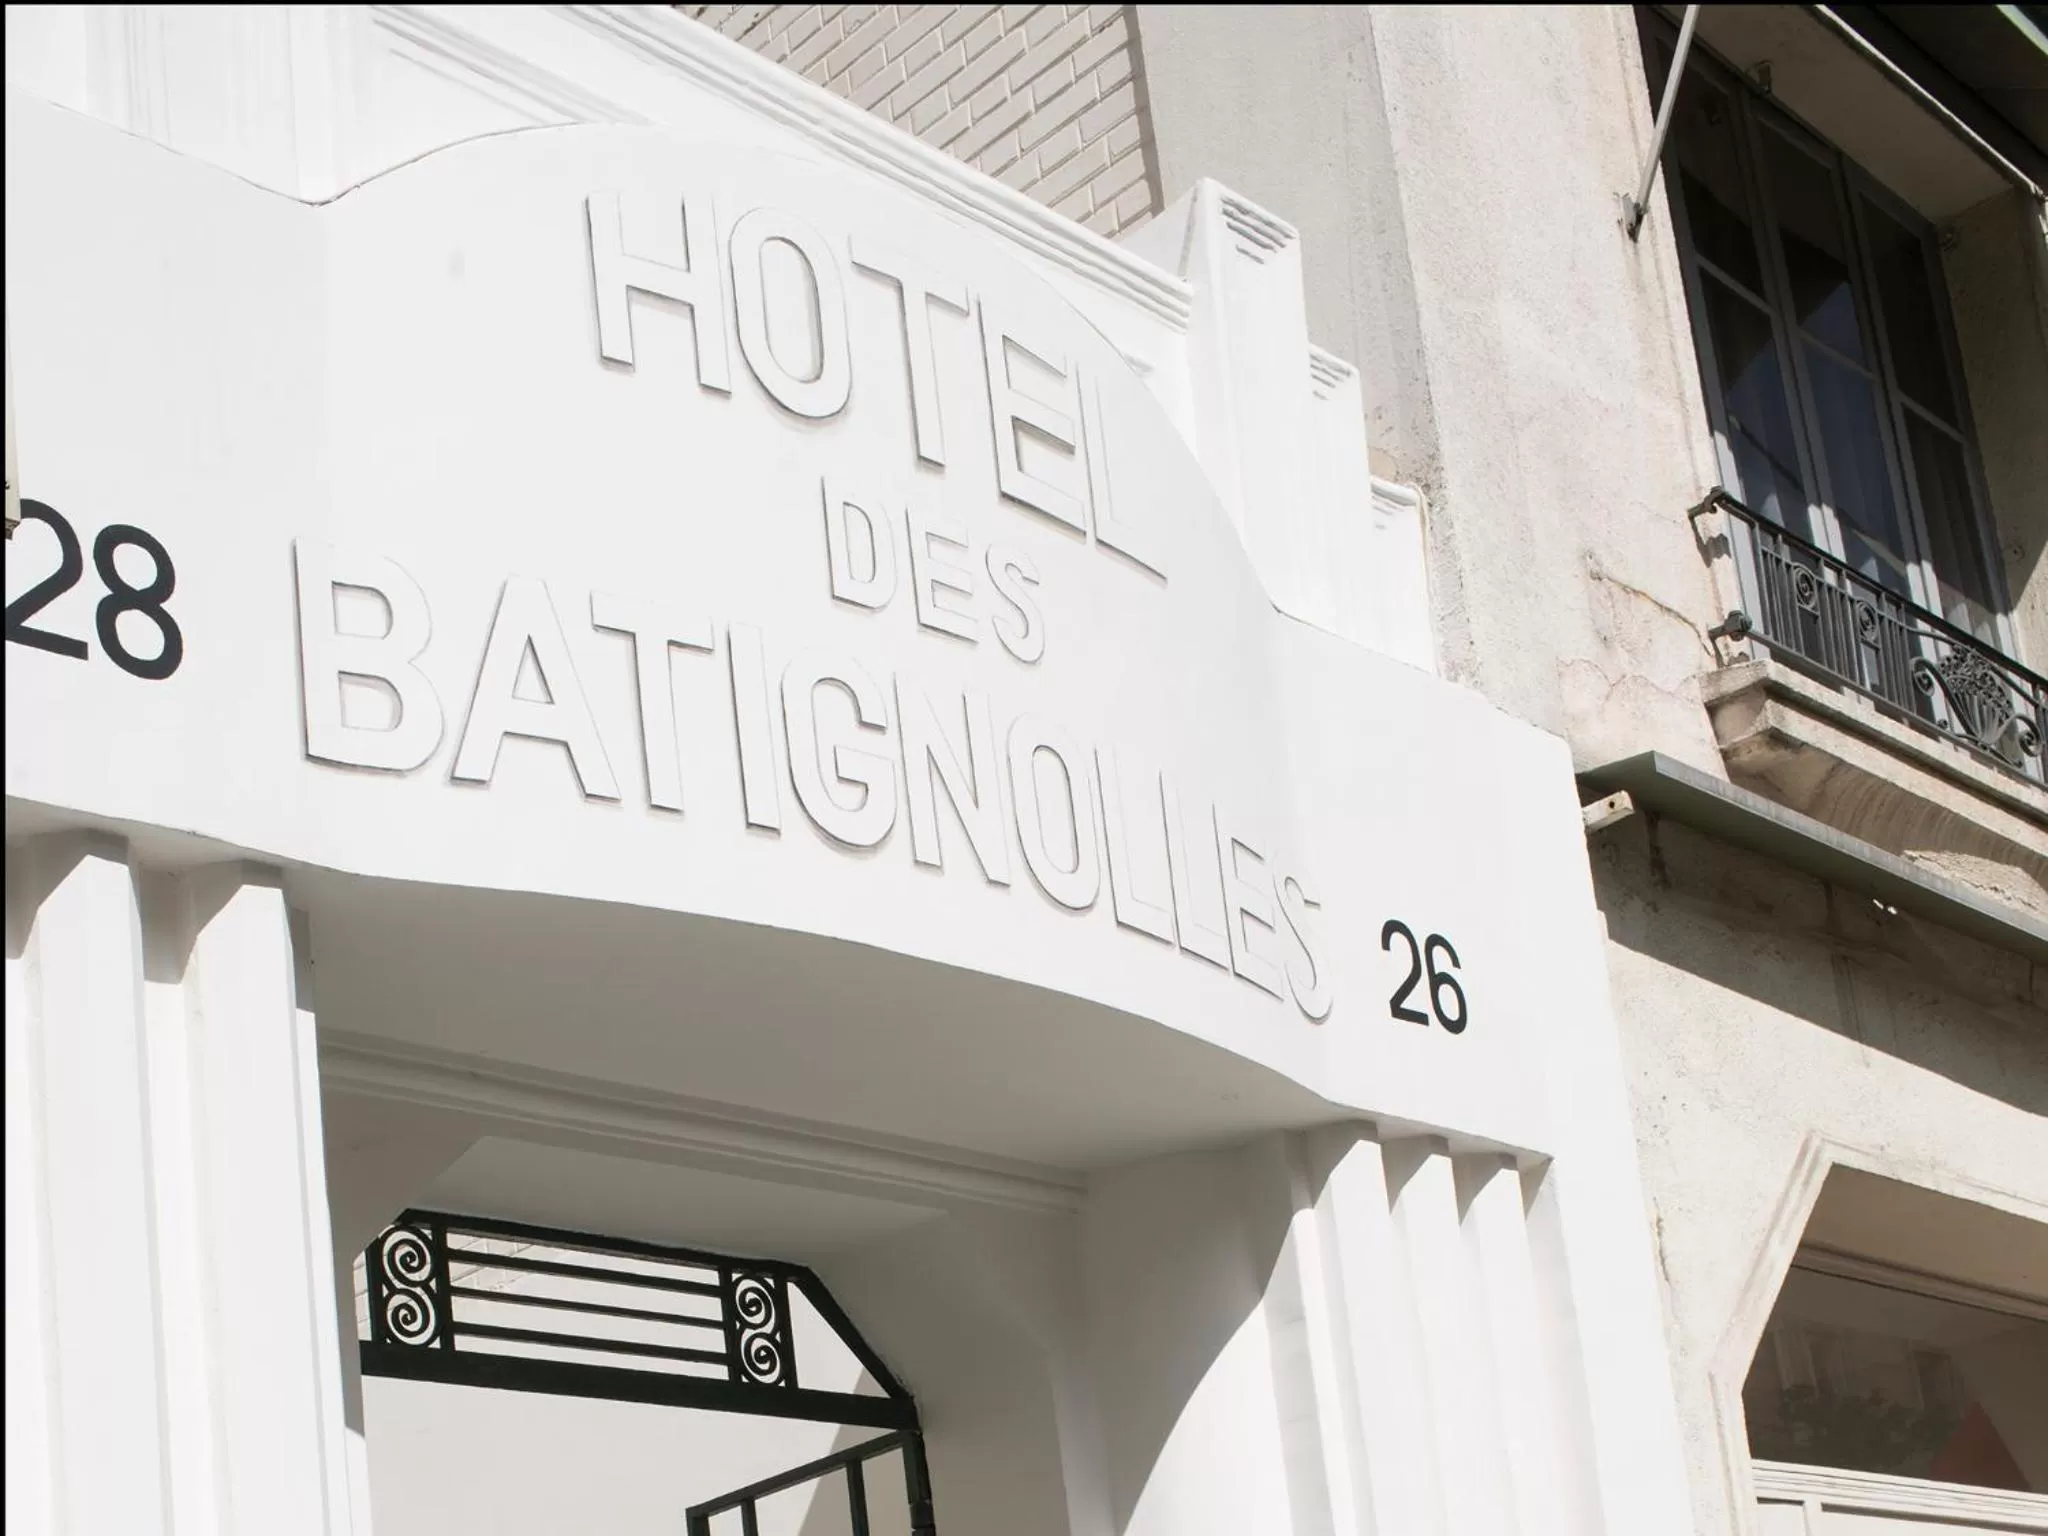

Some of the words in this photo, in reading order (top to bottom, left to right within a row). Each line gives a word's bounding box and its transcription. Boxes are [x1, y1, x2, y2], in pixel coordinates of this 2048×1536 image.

[582, 189, 1167, 584] HOTEL
[5, 498, 183, 680] 28
[820, 474, 1048, 665] DES
[292, 536, 1333, 1024] BATIGNOLLES
[1381, 918, 1468, 1035] 26
